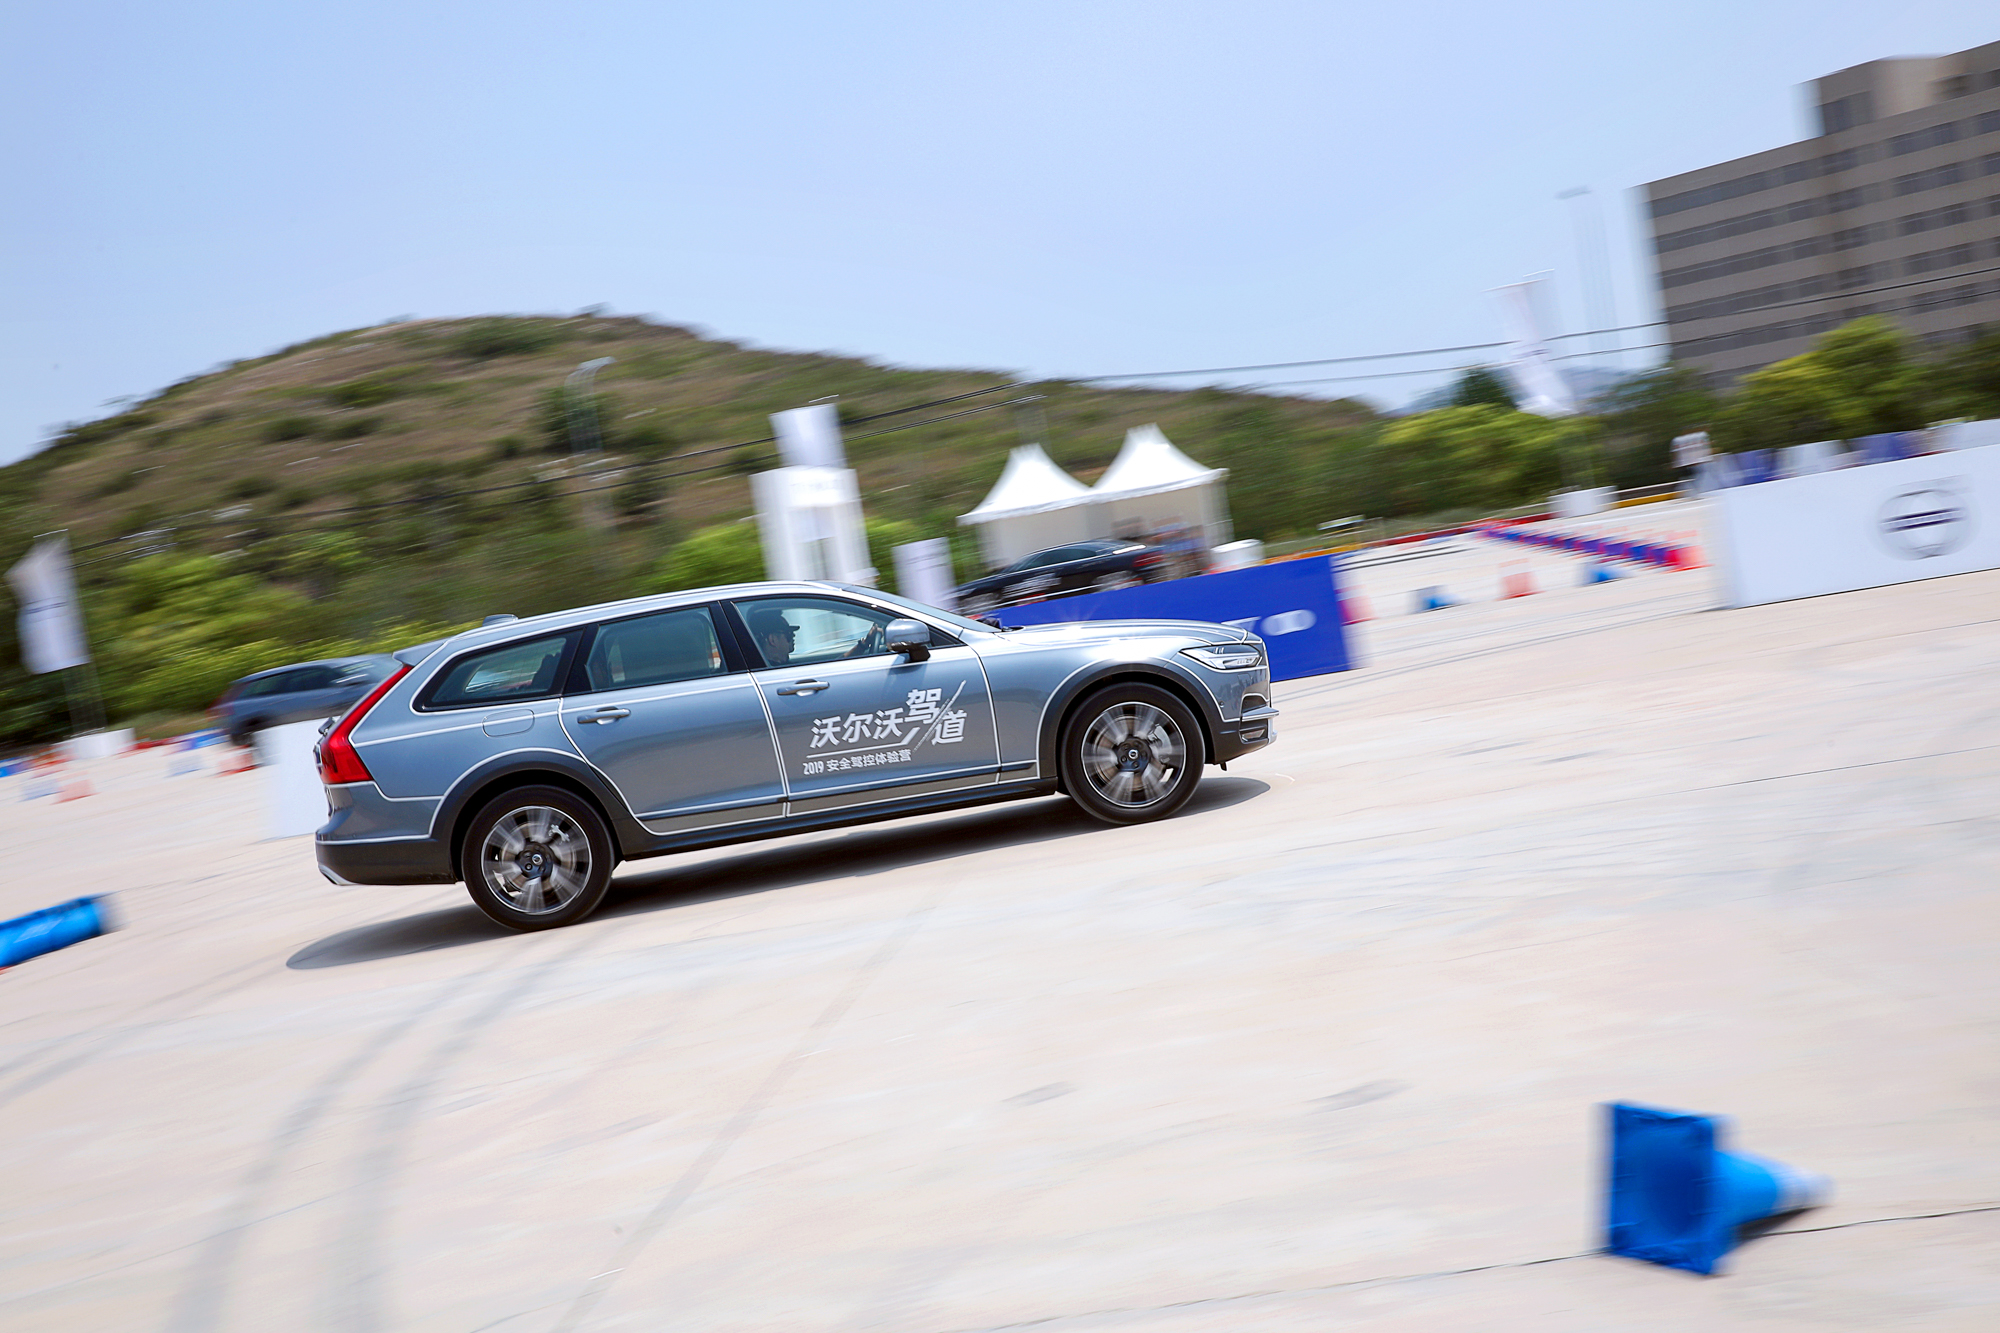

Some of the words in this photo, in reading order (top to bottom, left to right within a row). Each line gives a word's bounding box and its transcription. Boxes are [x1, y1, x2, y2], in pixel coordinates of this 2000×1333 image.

[803, 761, 825, 775] 2019
[826, 749, 911, 772] 安全驾控体验营
